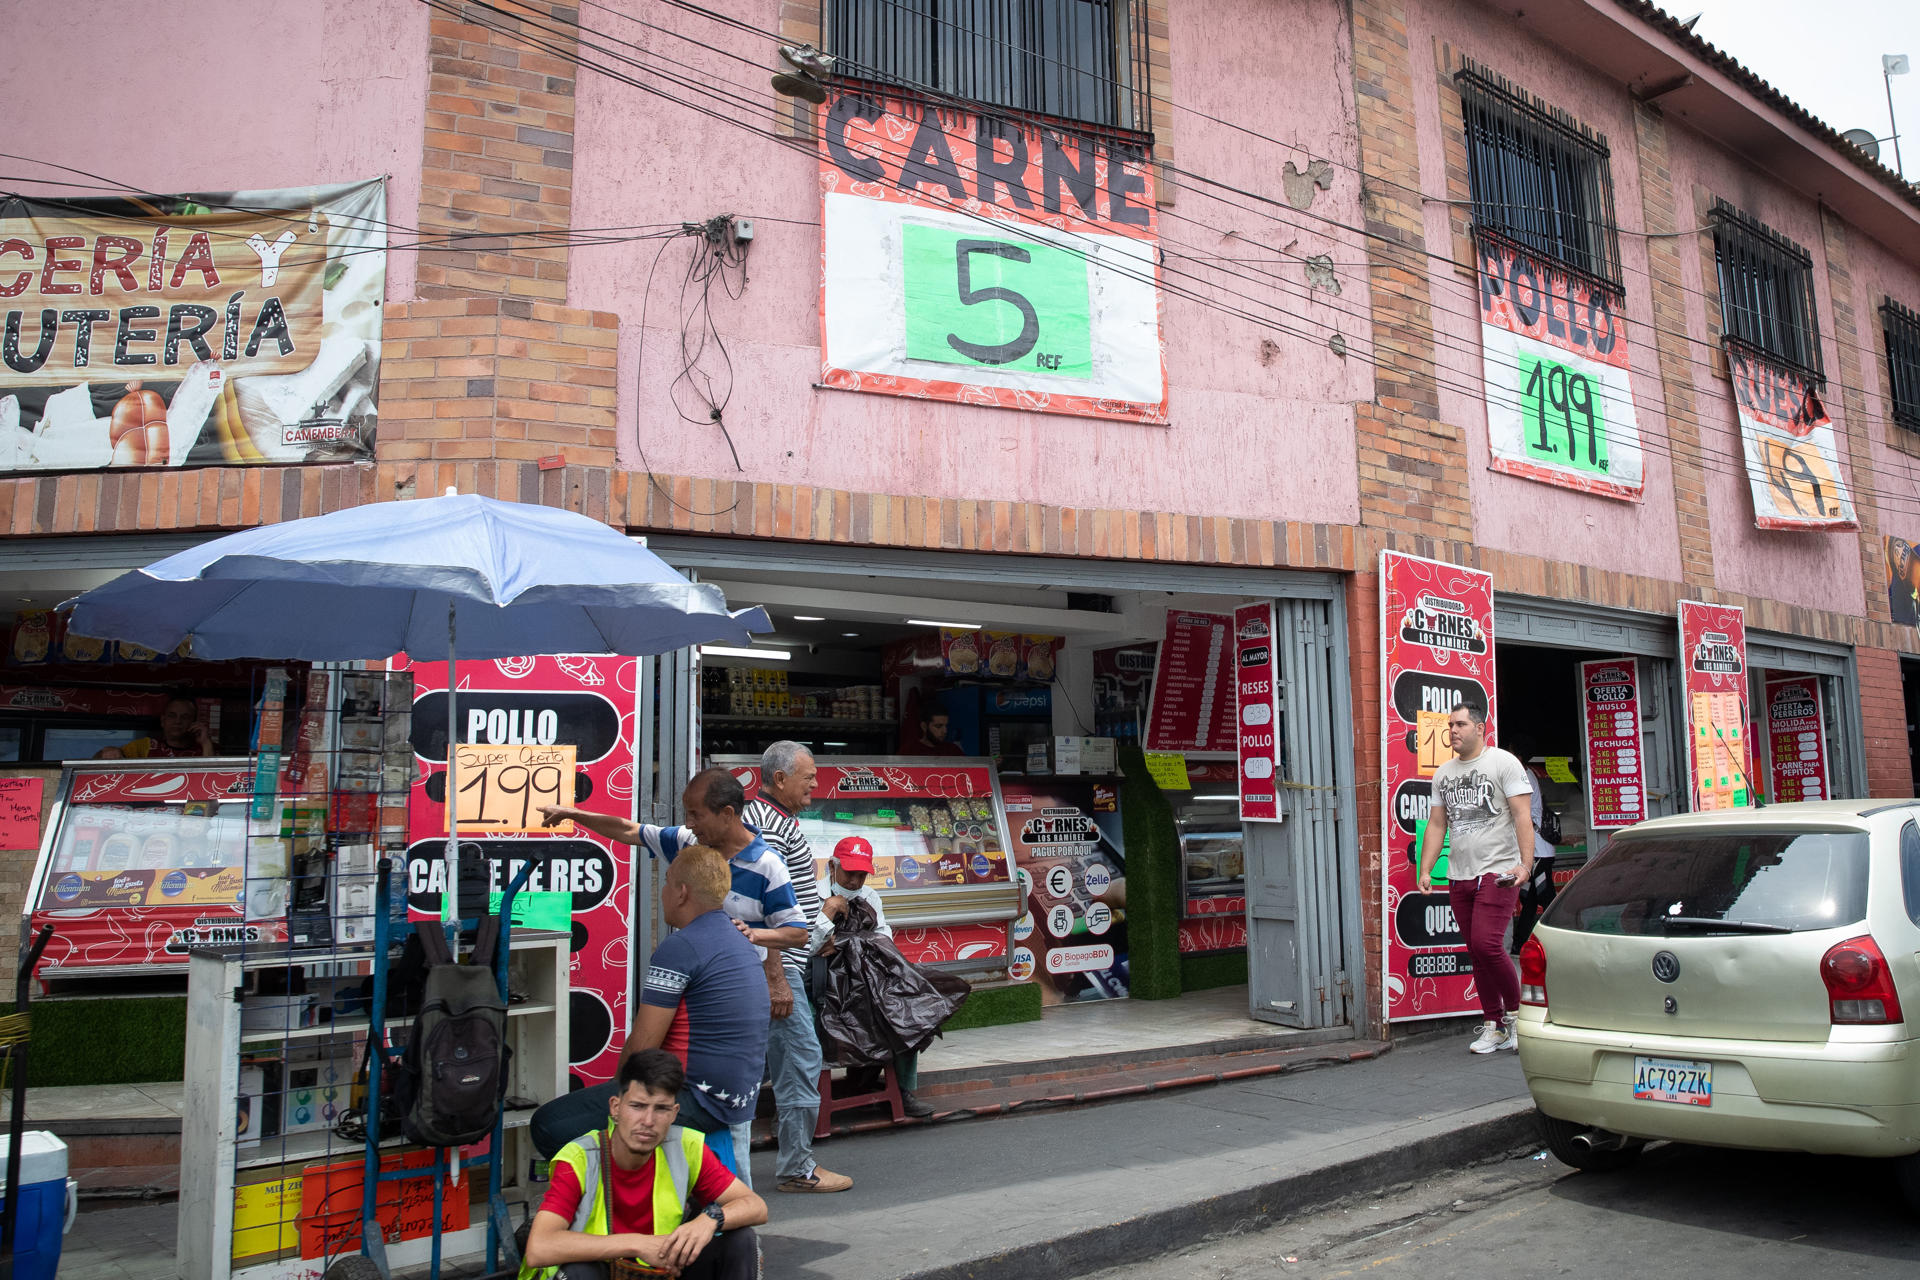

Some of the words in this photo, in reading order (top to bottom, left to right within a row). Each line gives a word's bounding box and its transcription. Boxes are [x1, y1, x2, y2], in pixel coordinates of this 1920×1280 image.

[826, 94, 1150, 226] CARNE
[245, 230, 298, 288] Y
[946, 239, 1040, 365] 5
[2, 291, 296, 373] UTERÍA
[1036, 351, 1063, 371] REF
[1526, 360, 1596, 466] 1.99
[1425, 596, 1462, 612] DISTRIBUIDORA
[1419, 632, 1434, 645] LOS
[1436, 634, 1470, 651] RAMÍREZ
[1249, 651, 1268, 661] MAYOR
[1242, 680, 1269, 695] RESES
[1593, 686, 1628, 695] OFERTA
[1014, 695, 1047, 708] pepsi
[1596, 692, 1625, 701] POLLO
[1596, 702, 1627, 711] MUSLO
[1772, 702, 1803, 712] OFERTA
[1773, 707, 1814, 718] PERREROS
[467, 708, 559, 745] POLLO
[1772, 719, 1805, 729] MOLIDA
[1243, 734, 1272, 748] POLLO
[1593, 740, 1635, 748] PECHUGA
[457, 746, 508, 768] Super
[1776, 761, 1803, 770] CARNE
[1782, 768, 1815, 777] PEPITOS
[1594, 777, 1640, 785] MILANESA
[456, 765, 562, 829] 1.99
[1400, 793, 1432, 820] CAR
[1037, 834, 1051, 842] LOS
[1031, 846, 1056, 857] PAGUE
[1057, 846, 1073, 856] POR
[1073, 845, 1092, 856] AQUI
[409, 859, 502, 893] CAE
[550, 858, 603, 893] RES
[1086, 873, 1109, 886] Zelle
[125, 880, 143, 889] gusta
[1425, 905, 1460, 937] QUES
[1065, 949, 1109, 961] BiopagoBDV
[1415, 954, 1457, 975] 888.888
[1638, 1066, 1707, 1096] AC792ZK
